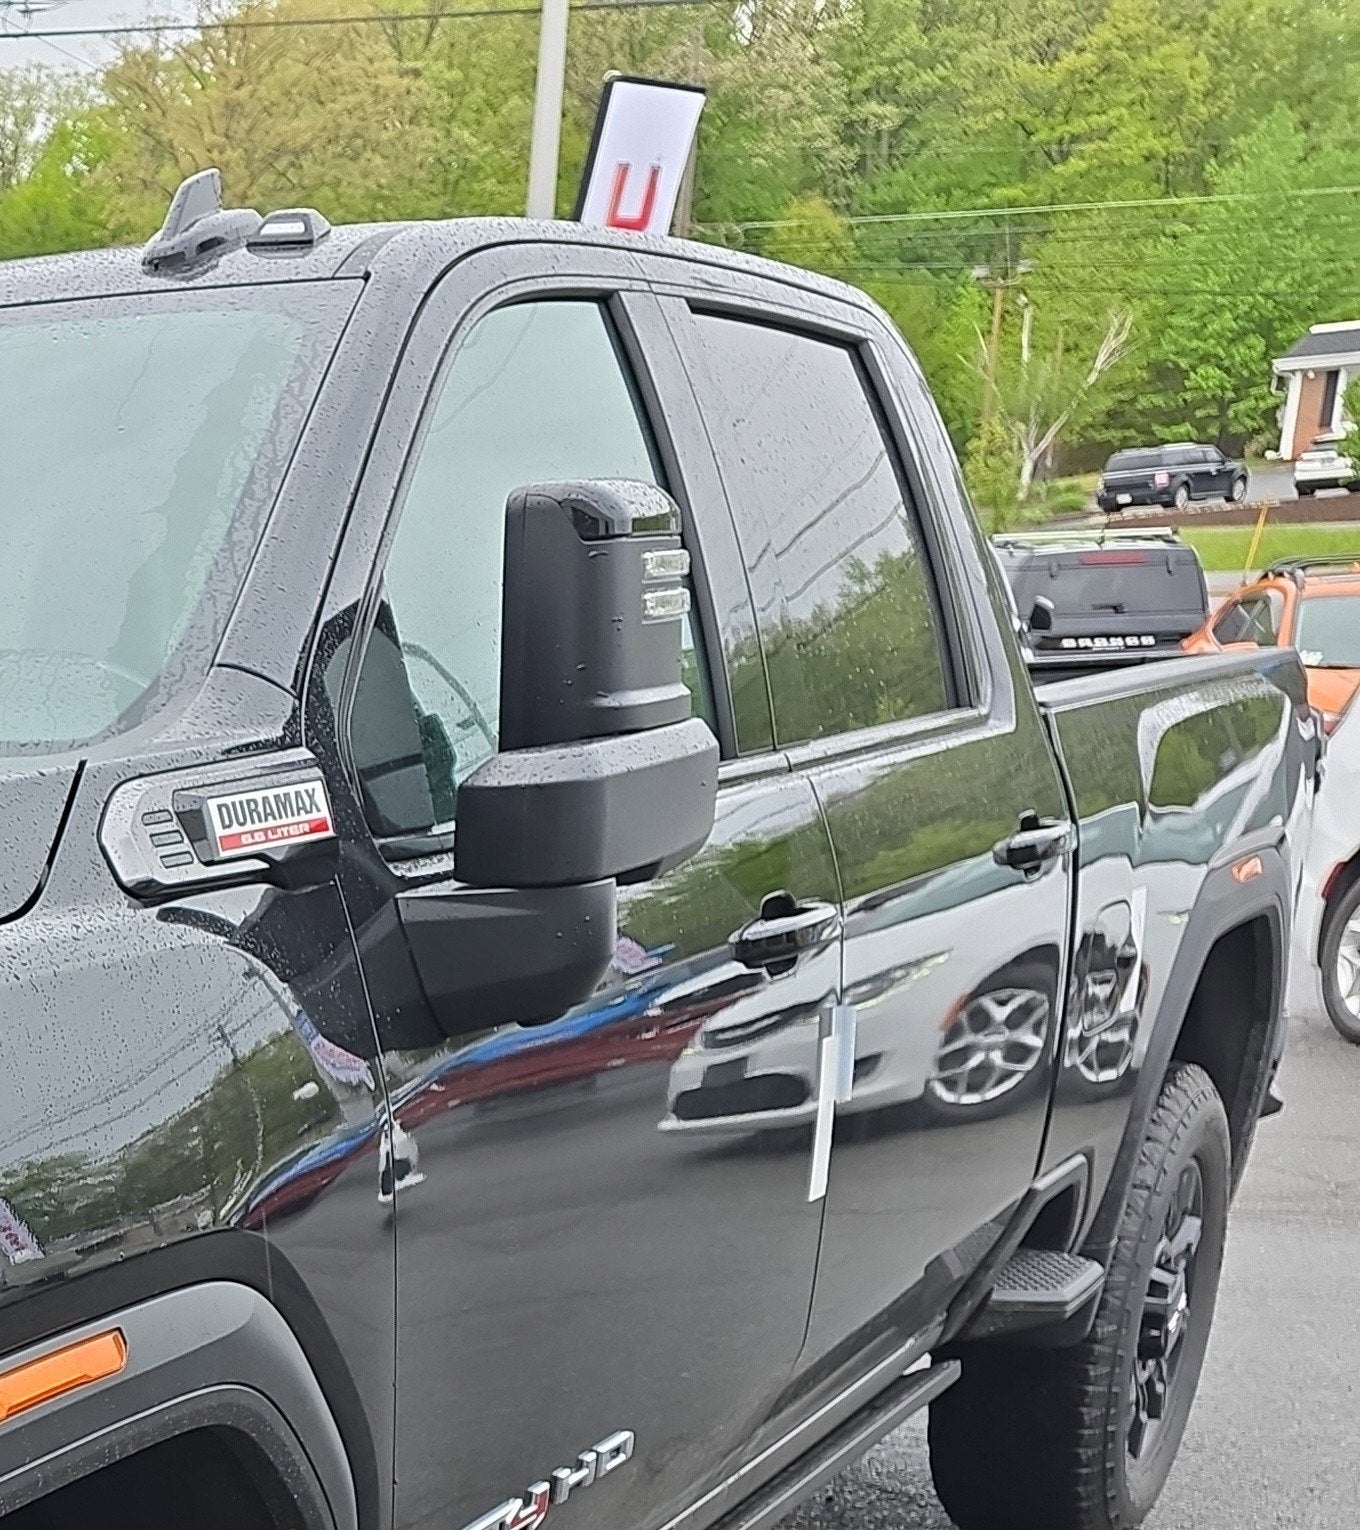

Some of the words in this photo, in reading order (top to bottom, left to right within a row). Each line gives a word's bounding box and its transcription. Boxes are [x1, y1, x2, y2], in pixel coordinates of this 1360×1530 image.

[606, 161, 663, 232] U
[216, 787, 322, 830] DURAMAX
[240, 831, 266, 845] 6.6
[266, 822, 311, 841] LITER
[551, 1429, 636, 1505] HD
